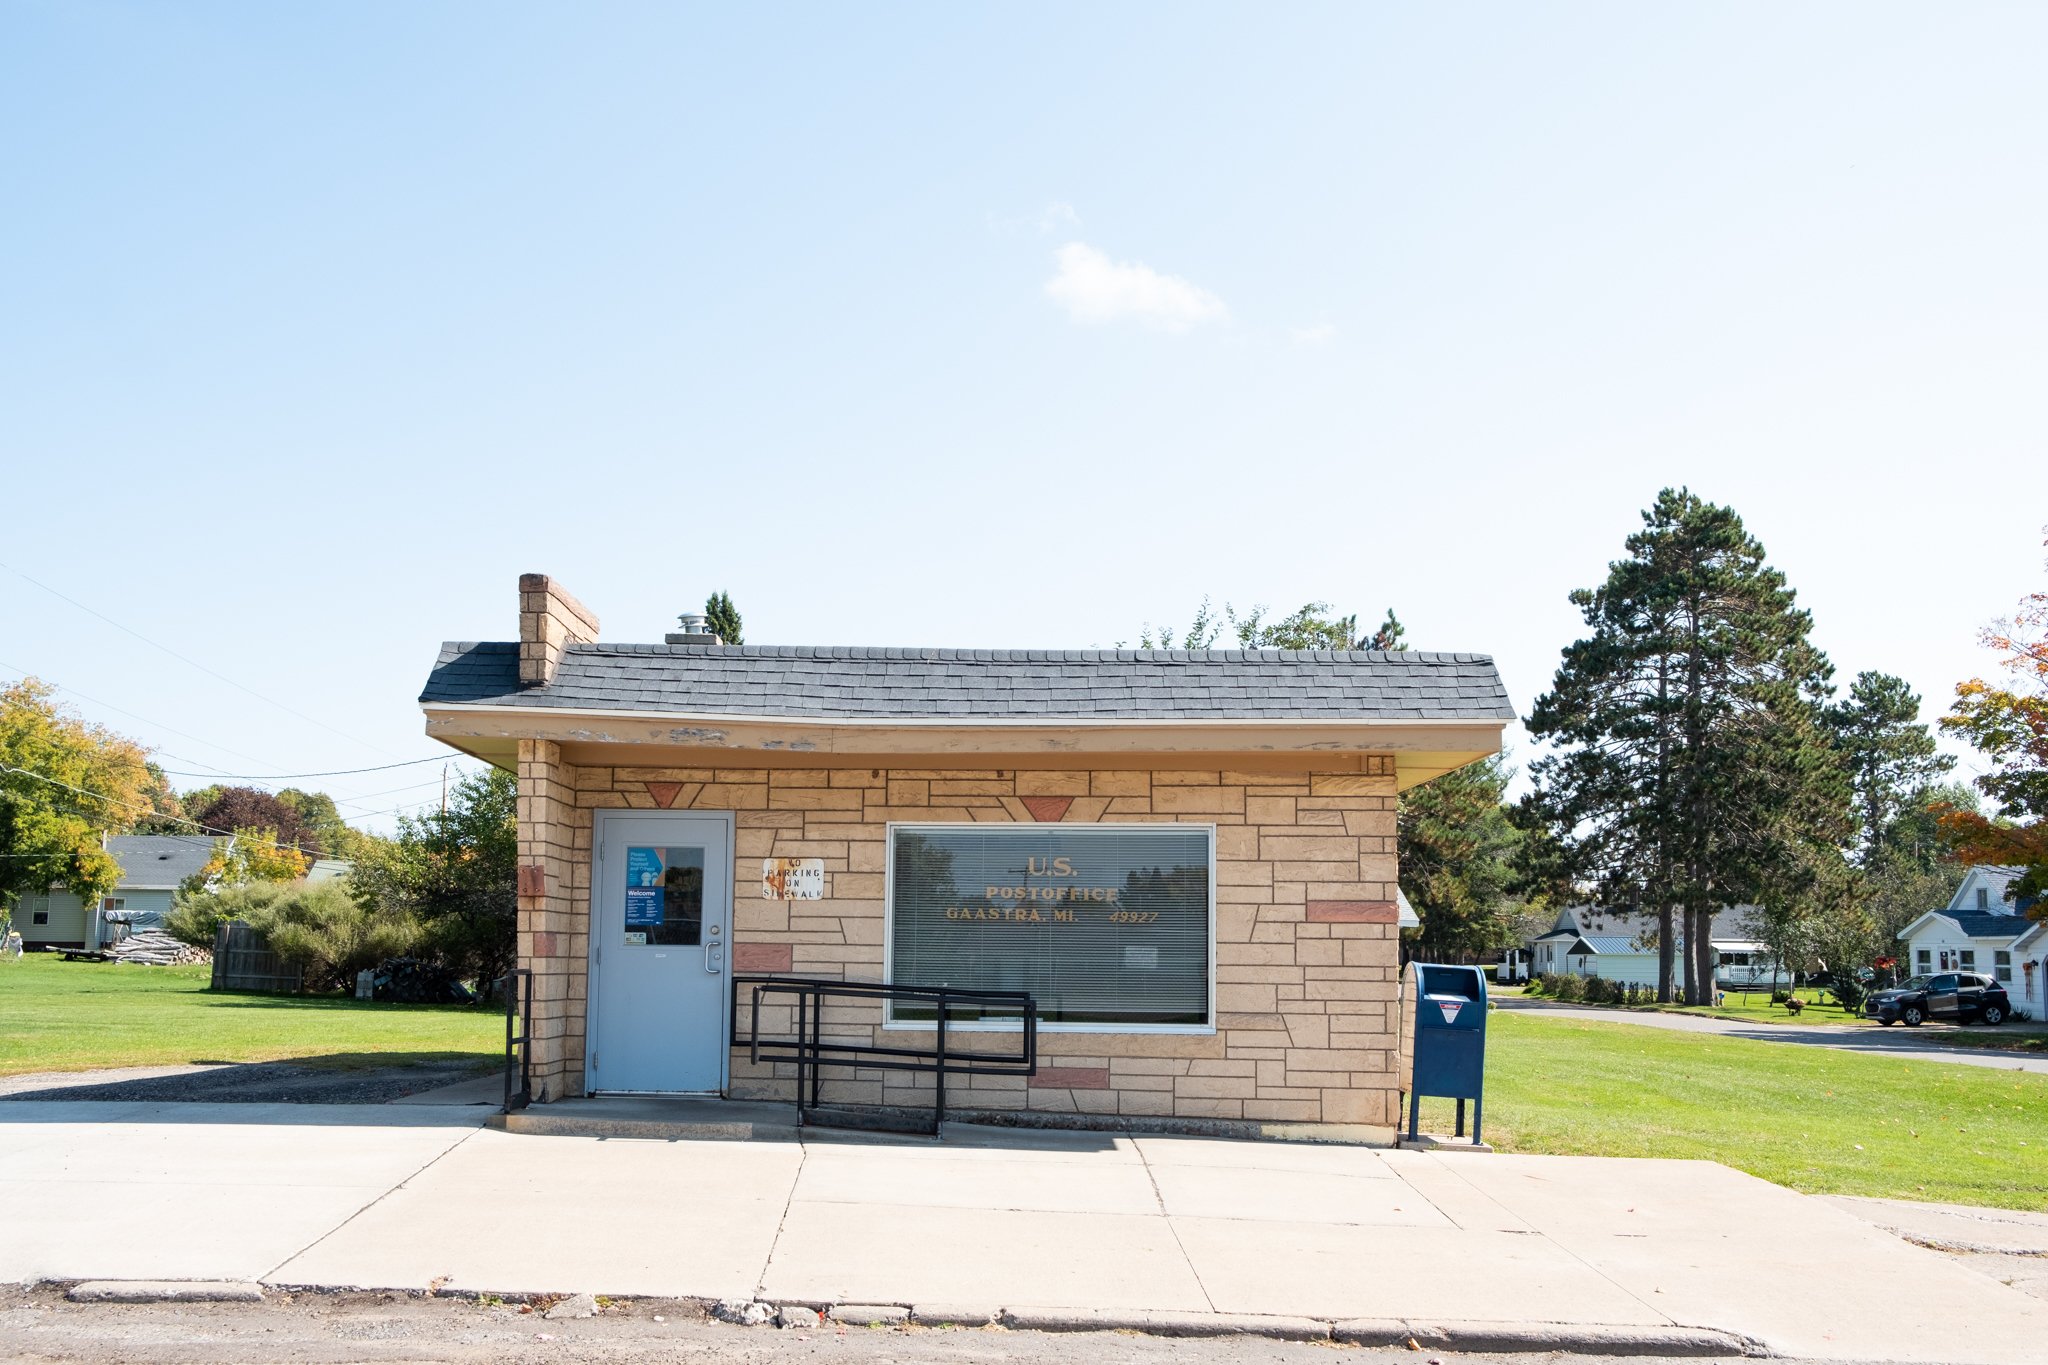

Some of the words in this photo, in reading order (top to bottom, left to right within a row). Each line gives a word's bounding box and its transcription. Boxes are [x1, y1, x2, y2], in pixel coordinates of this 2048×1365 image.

[1028, 857, 1078, 876] U.S.
[767, 869, 820, 877] PARKING
[786, 879, 800, 887] ON
[1109, 911, 1159, 923] 49927
